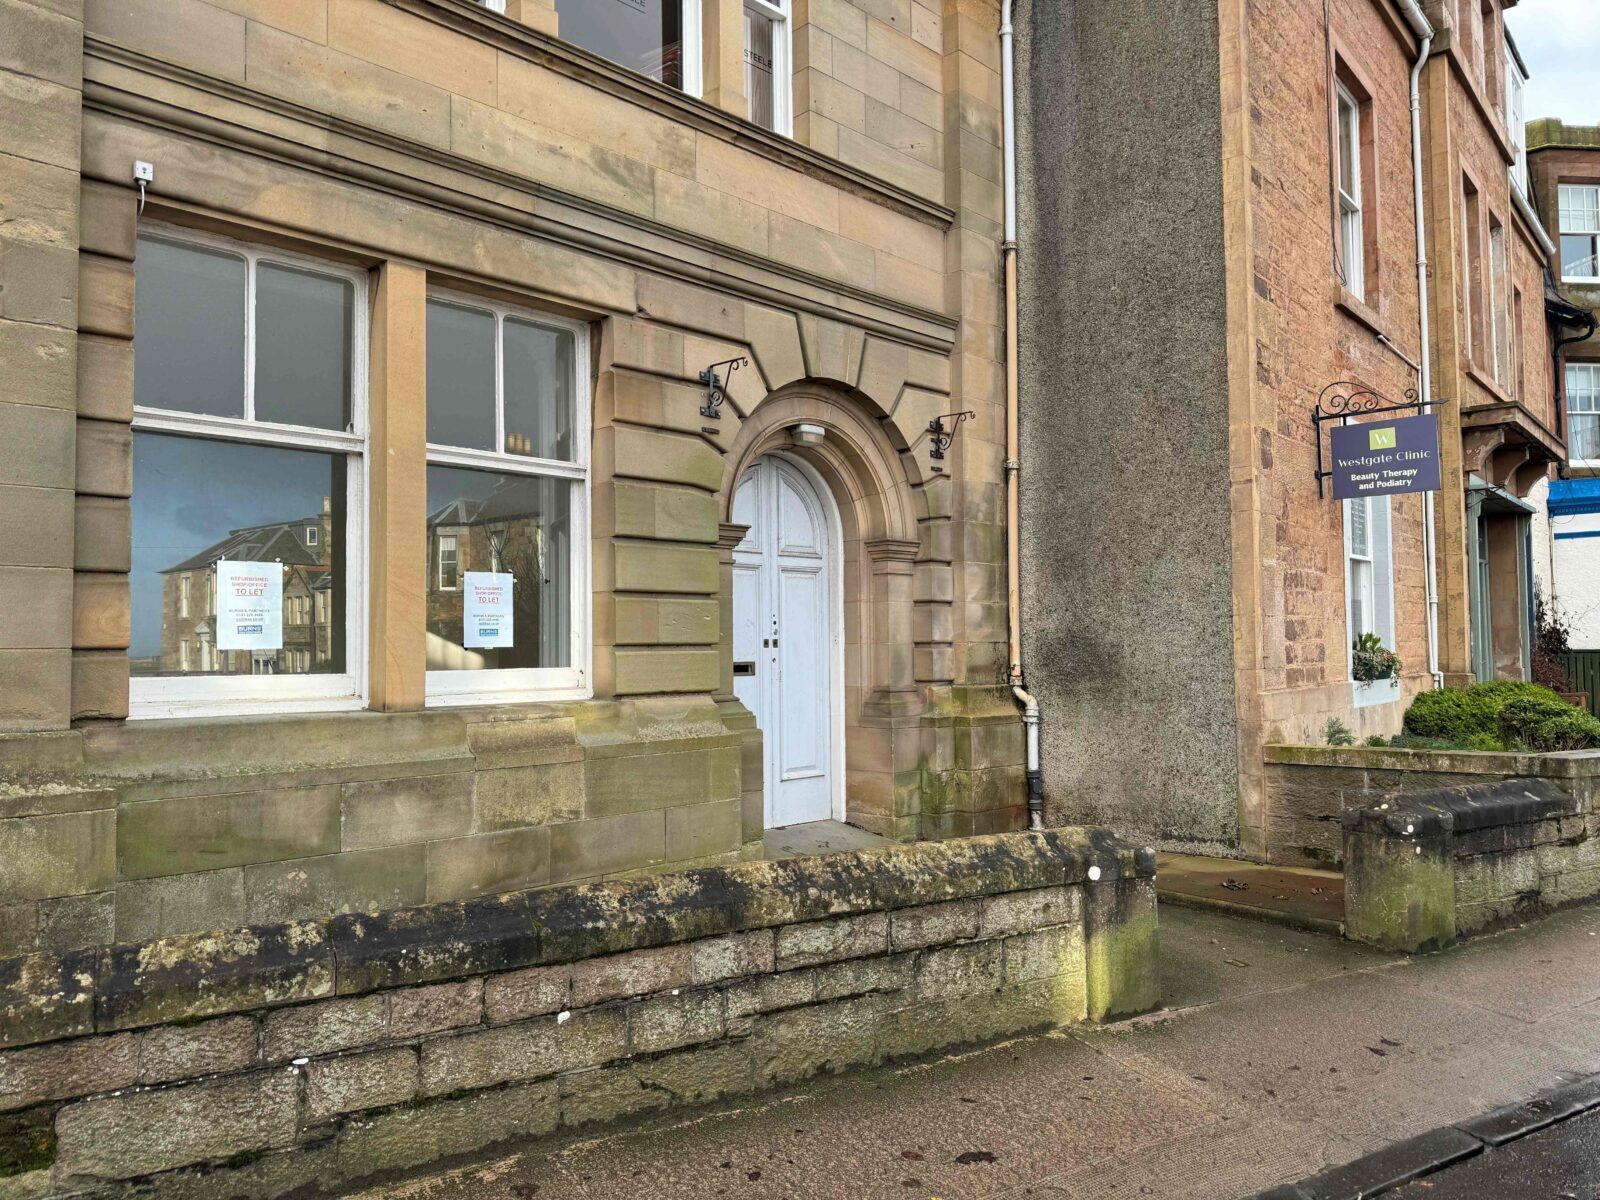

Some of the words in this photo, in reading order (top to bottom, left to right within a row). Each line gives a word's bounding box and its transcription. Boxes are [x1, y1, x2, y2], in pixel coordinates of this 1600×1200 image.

[1375, 432, 1390, 446] W
[1338, 454, 1393, 468] Westgate
[1396, 450, 1431, 461] Clinic
[1351, 472, 1380, 482] Beauty
[1382, 468, 1418, 478] Therapy
[1359, 481, 1374, 490] and
[1376, 478, 1413, 488] Podiatry
[249, 588, 264, 596] LET
